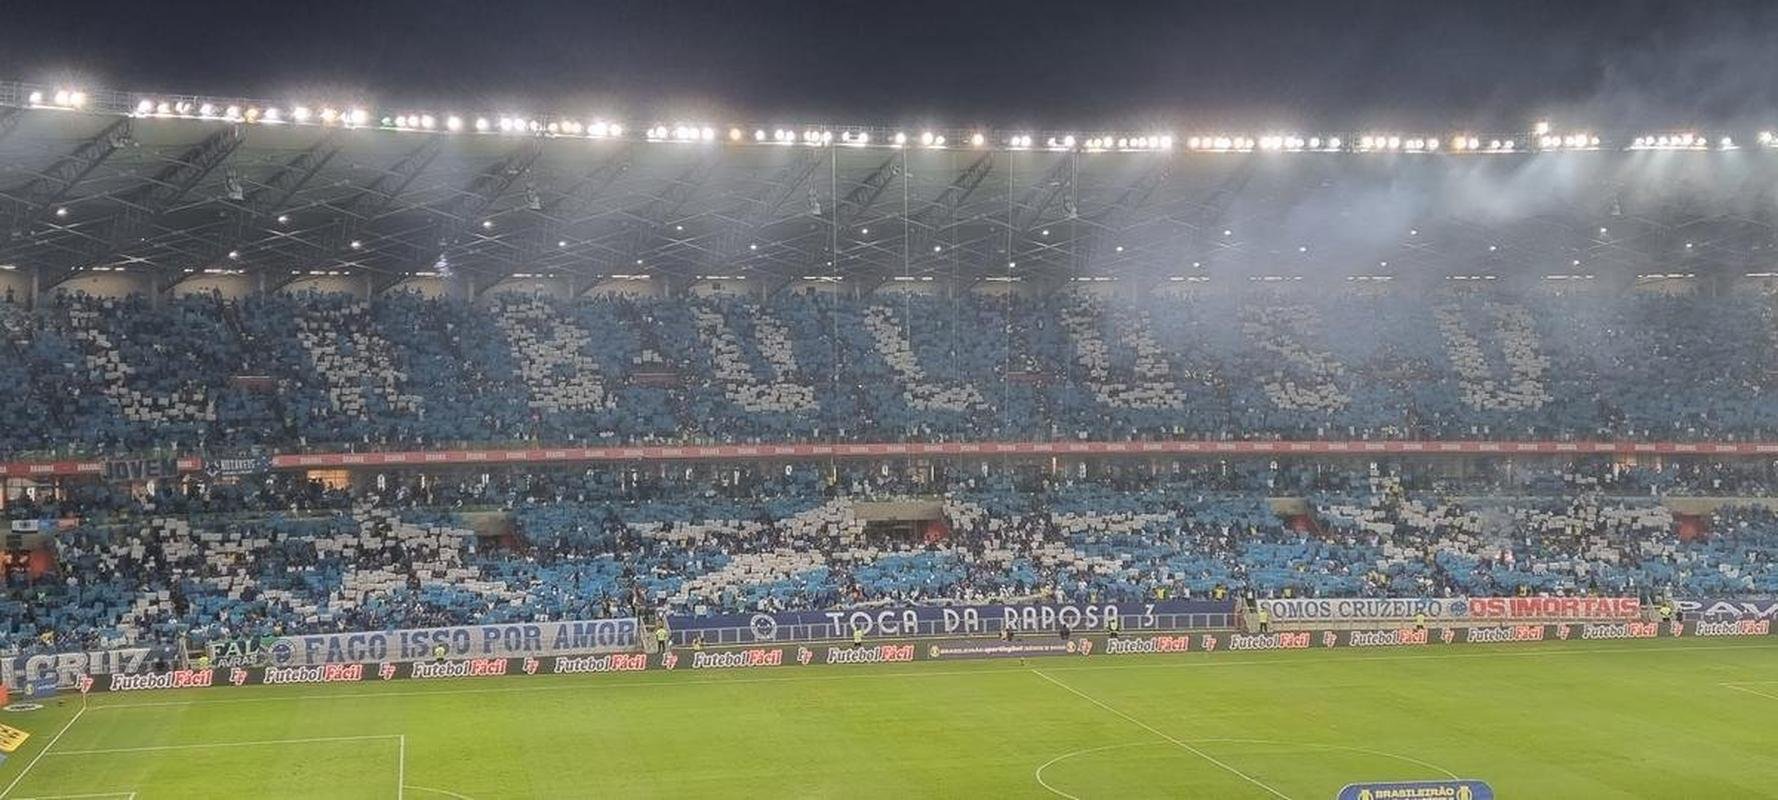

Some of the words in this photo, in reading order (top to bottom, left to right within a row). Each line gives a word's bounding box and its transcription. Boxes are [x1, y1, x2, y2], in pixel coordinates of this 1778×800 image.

[1339, 600, 1442, 618] CRUZEIRO
[826, 609, 918, 636] TOCA
[943, 607, 979, 633] DA
[1004, 605, 1119, 633] RAPOSA
[1144, 604, 1154, 627] 3
[1349, 630, 1399, 645] Futebol
[1467, 626, 1515, 643] Futebol
[1582, 623, 1629, 640] Futebol
[1695, 621, 1740, 637] Futebol
[400, 628, 471, 659] ISSO
[482, 625, 542, 654] POR
[553, 619, 636, 650] AMOR
[1106, 638, 1157, 654] Futebol
[1229, 634, 1280, 650] Futebol
[692, 652, 749, 668] Futebol
[827, 648, 881, 664] Futebol
[411, 660, 470, 678] Futebol
[554, 656, 611, 674] Futebol
[110, 673, 173, 691] Futebol
[264, 667, 324, 684] Futebol
[1375, 786, 1454, 798] BRASILEIRÃO
